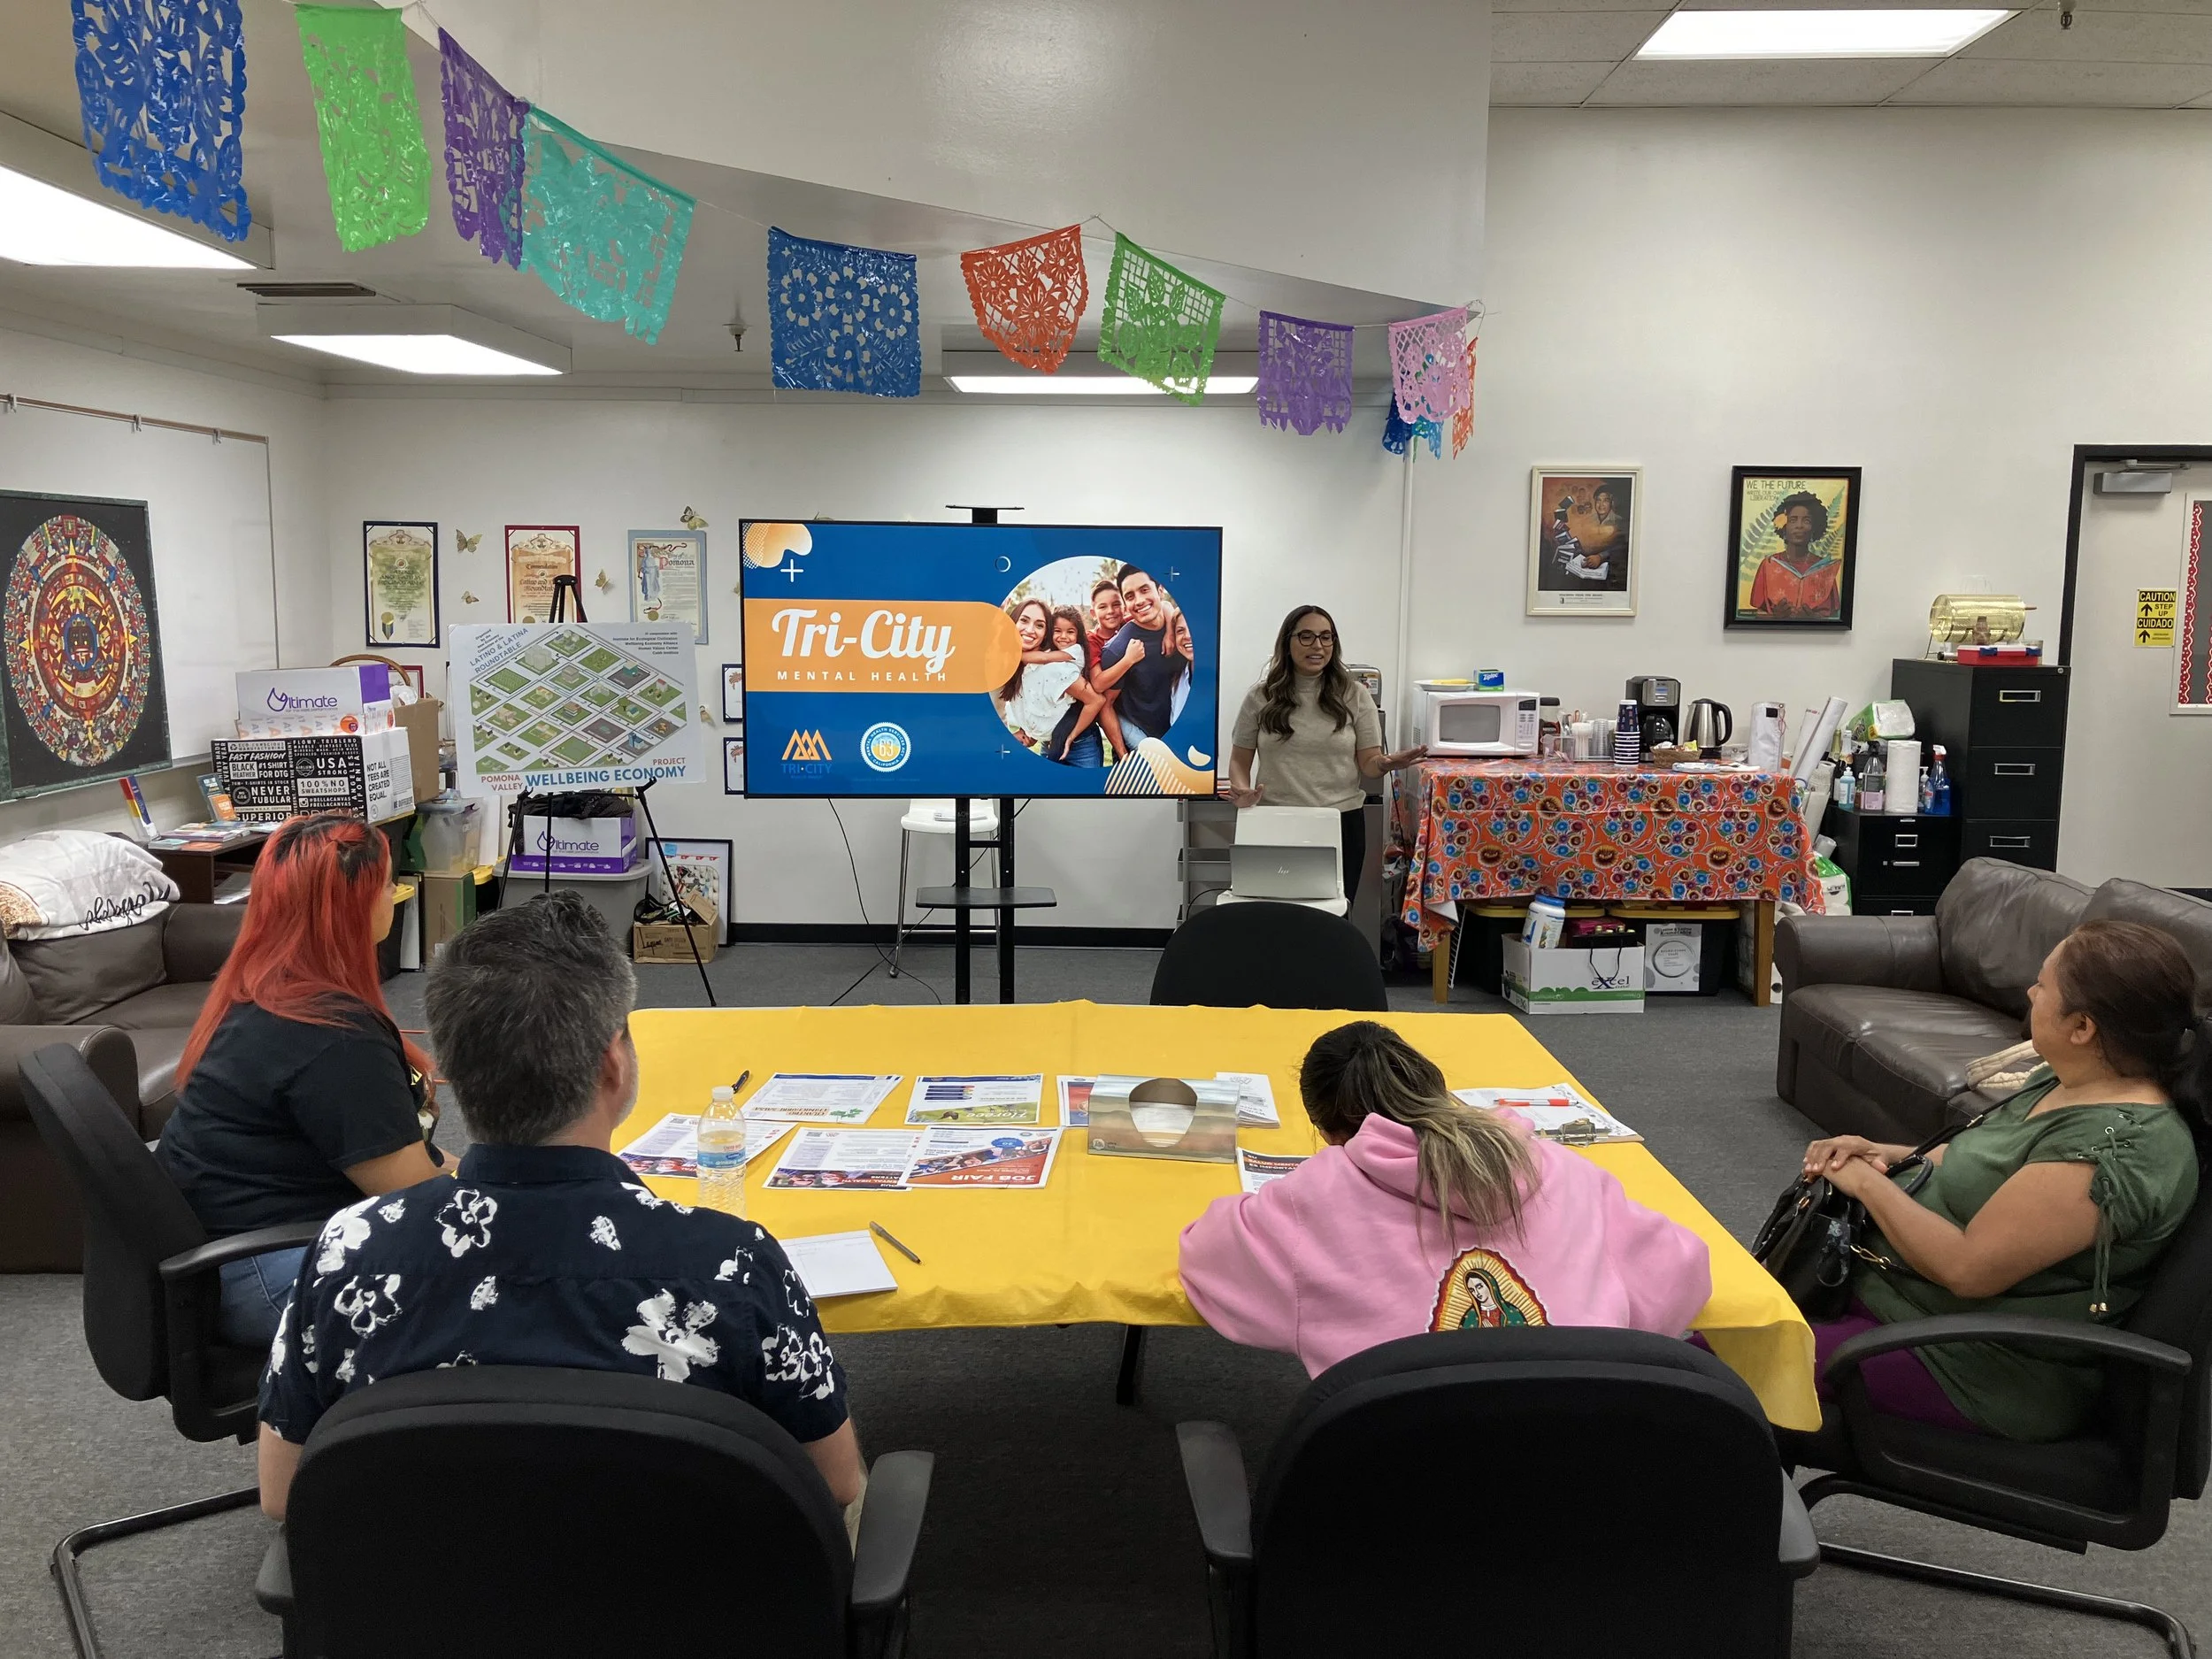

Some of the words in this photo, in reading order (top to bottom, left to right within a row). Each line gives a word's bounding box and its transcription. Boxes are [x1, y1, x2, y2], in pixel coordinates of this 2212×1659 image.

[1746, 480, 1757, 489] WE
[1762, 480, 1775, 489] THE
[1778, 480, 1806, 490] FUTURE
[2139, 592, 2176, 602] CAUTION
[2138, 618, 2173, 628] CUIDADO
[470, 647, 496, 666] LATINO
[503, 627, 529, 646] LATINA
[772, 609, 956, 674] Tri-City
[474, 641, 522, 673] ROUNDTABLE
[777, 671, 856, 680] MENTAL
[871, 672, 946, 681] HEALTH
[266, 687, 338, 711] Ultimate
[879, 739, 894, 757] 63
[229, 753, 250, 762] FAST
[250, 752, 286, 761] FASHION
[232, 763, 255, 772] BLACK
[316, 757, 347, 769] USA
[366, 763, 378, 772] NOT
[274, 770, 288, 779] DTG
[347, 755, 357, 800] ANGELES
[367, 772, 380, 782] TEES
[380, 770, 389, 779] ARE
[480, 774, 521, 783] POMONA
[526, 771, 610, 787] WELLBEING
[614, 765, 686, 781] ECONOMY
[330, 779, 345, 787] NO
[354, 755, 365, 817] ALIFORNIA
[368, 780, 390, 792] CREATED
[491, 782, 523, 791] VALLEY
[250, 786, 290, 796] NEVER
[252, 795, 291, 804] TUBULAR
[369, 791, 388, 802] EQUAL.
[235, 812, 292, 822] SUPERIOR
